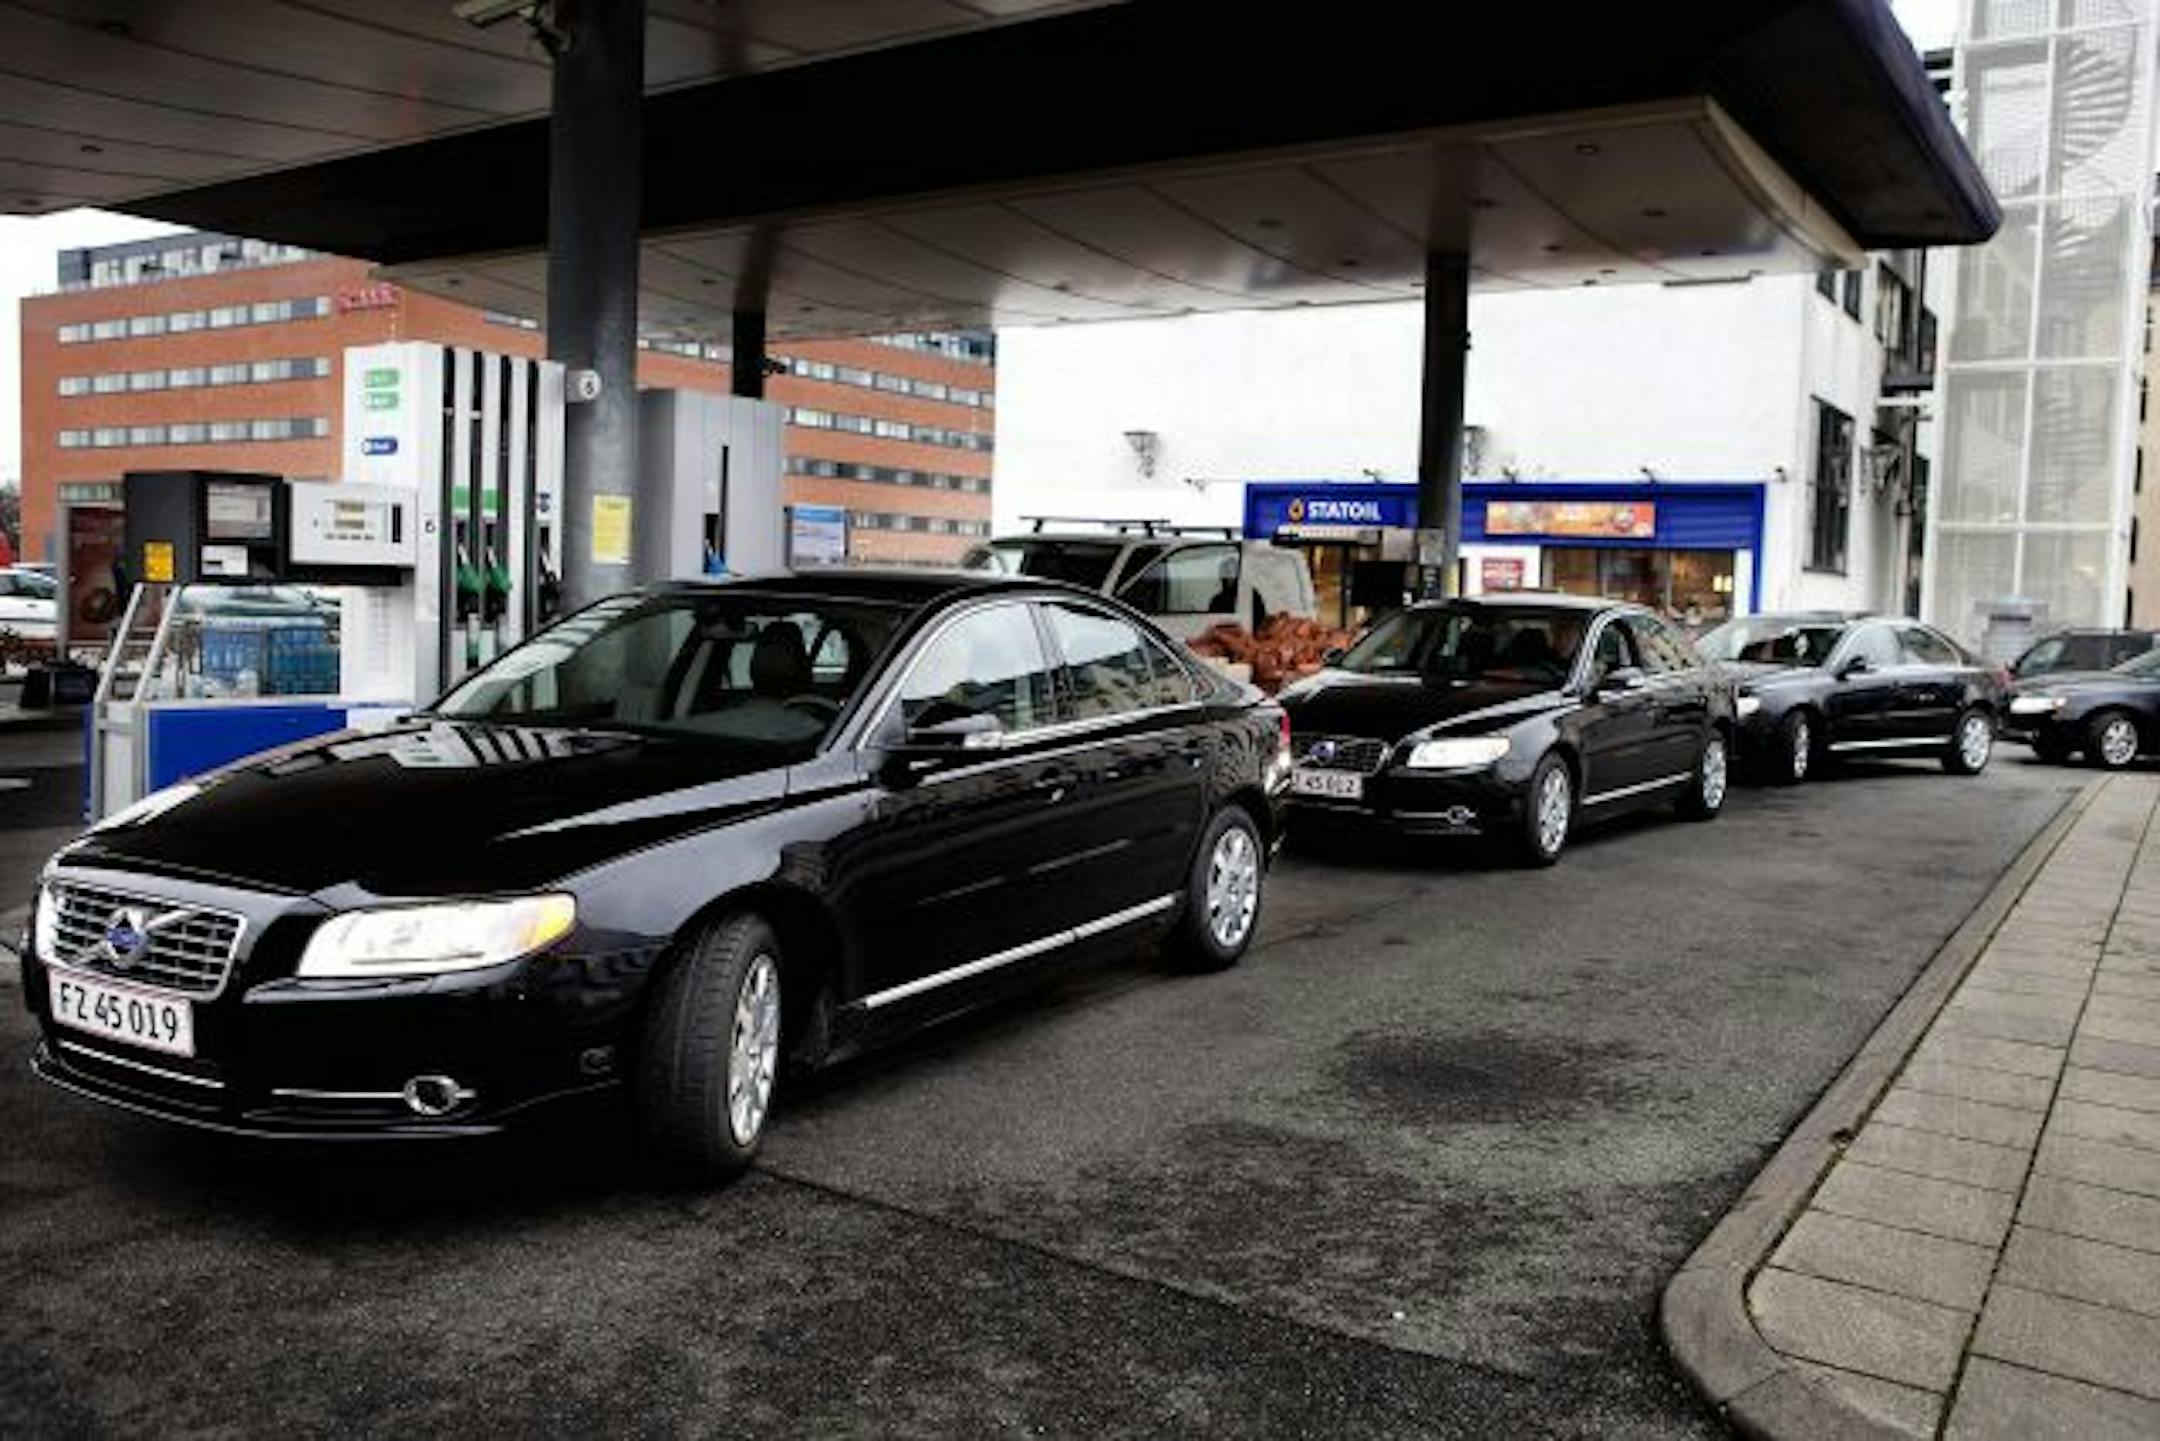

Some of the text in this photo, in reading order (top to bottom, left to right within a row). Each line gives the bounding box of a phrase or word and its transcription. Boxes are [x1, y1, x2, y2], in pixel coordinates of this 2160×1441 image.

[1308, 501, 1381, 521] STATOIL
[61, 983, 177, 1042] FZ 45 019
